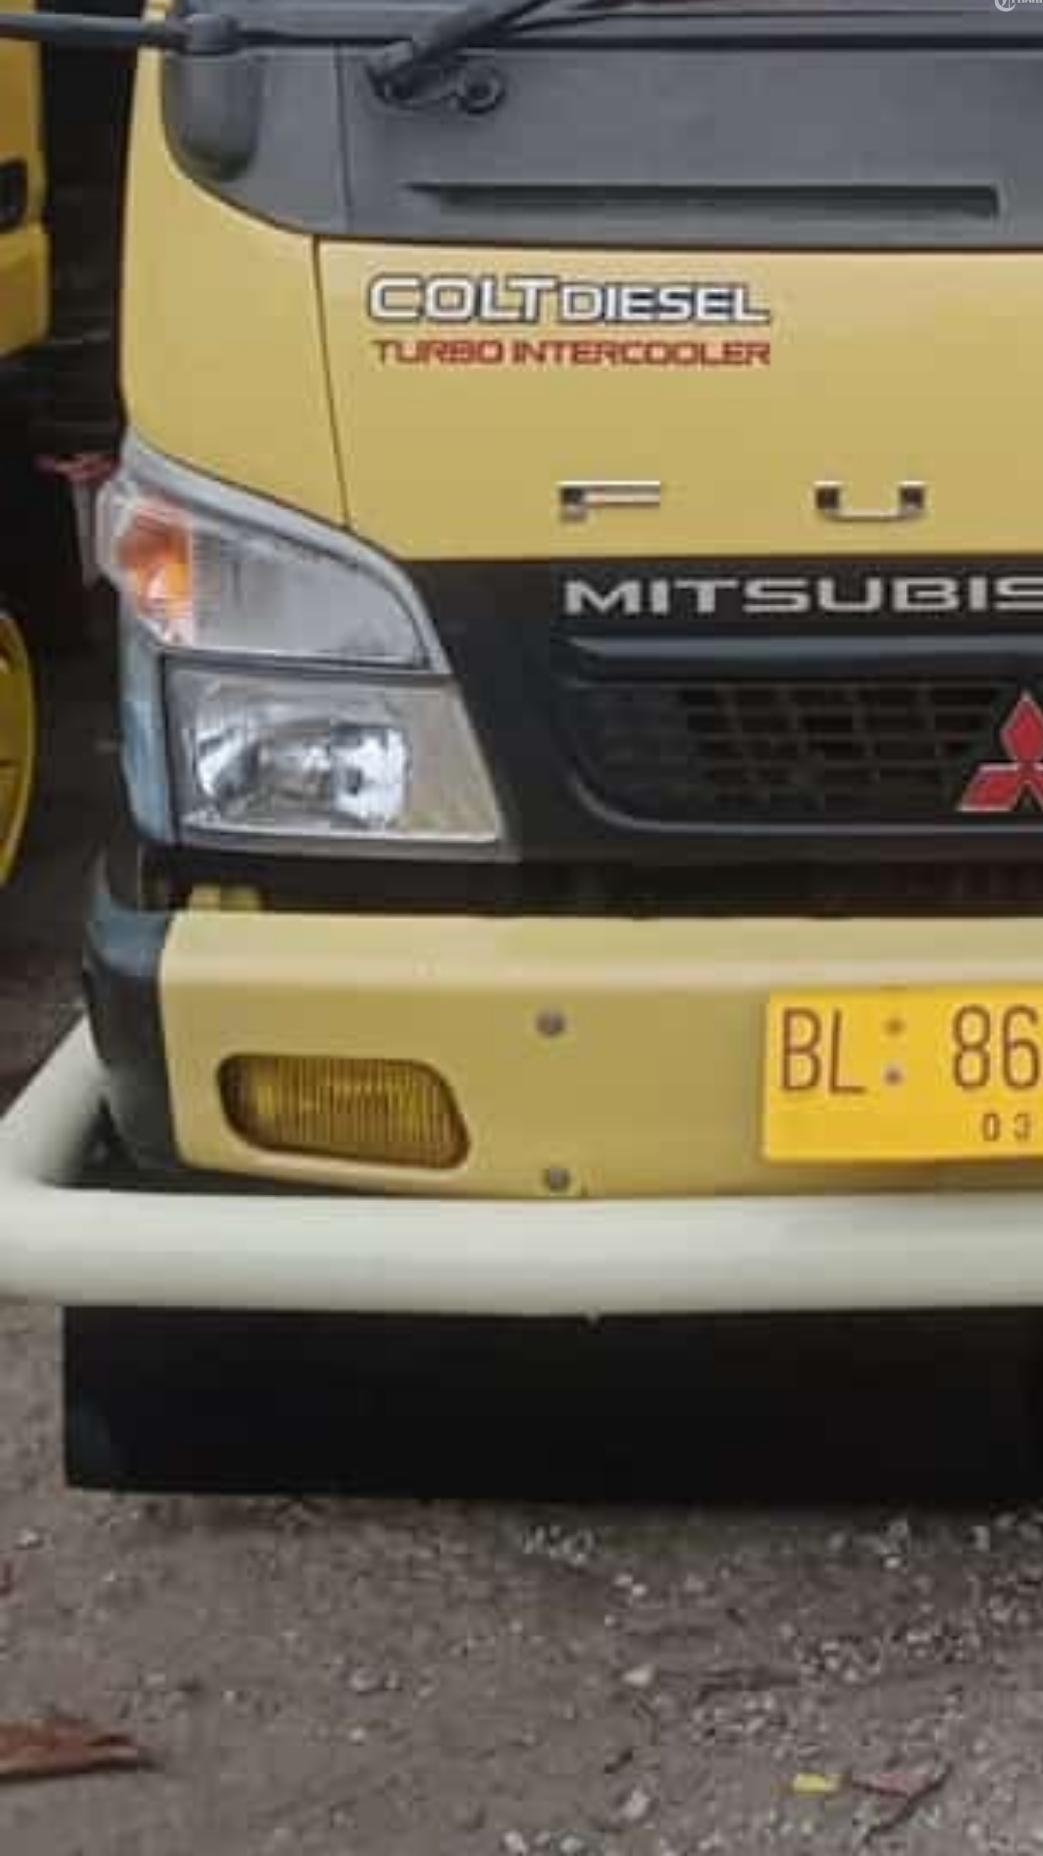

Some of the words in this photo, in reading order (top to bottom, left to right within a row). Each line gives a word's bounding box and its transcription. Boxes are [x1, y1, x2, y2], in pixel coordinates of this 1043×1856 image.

[368, 274, 556, 324] COLT
[560, 282, 771, 323] DIESEL
[370, 340, 502, 365] TURBO
[511, 339, 770, 365] INTERCOOLER
[780, 1008, 868, 1095] BL
